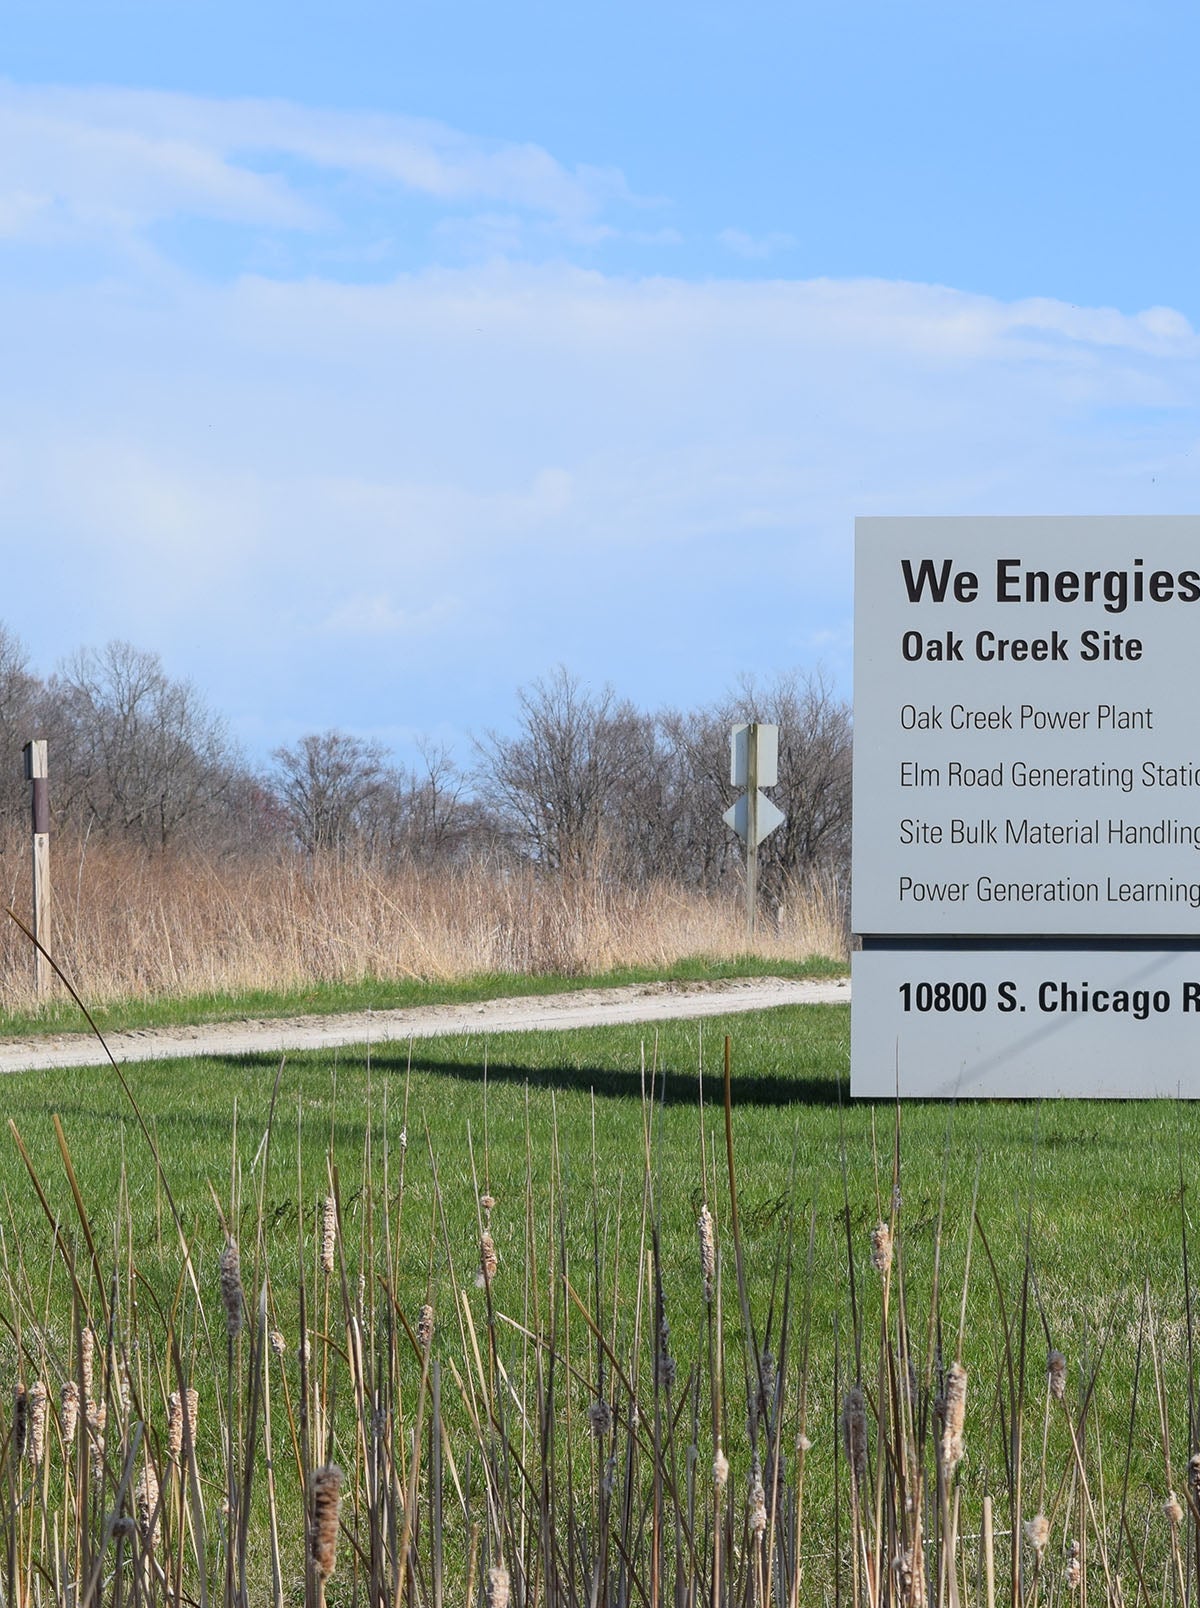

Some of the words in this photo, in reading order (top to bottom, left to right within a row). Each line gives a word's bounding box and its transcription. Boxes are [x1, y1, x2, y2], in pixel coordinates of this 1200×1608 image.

[900, 559, 979, 603] We
[902, 630, 965, 662] Oak
[975, 630, 1069, 662] Creek
[1080, 630, 1143, 662] Site
[900, 704, 943, 730] Oak
[950, 704, 1013, 730] Creek
[1020, 704, 1091, 730] Power
[1097, 704, 1153, 730] Plant
[900, 761, 940, 787] Elm
[948, 761, 1003, 787] Road
[1011, 761, 1133, 793] Generating
[899, 818, 943, 845] Site
[951, 819, 998, 845] Bulk
[1005, 819, 1099, 845] Material
[899, 876, 970, 902] Power
[976, 876, 1099, 902] Generation
[899, 982, 987, 1013] 10800
[997, 980, 1026, 1013] S.
[1038, 981, 1171, 1021] Chicago
